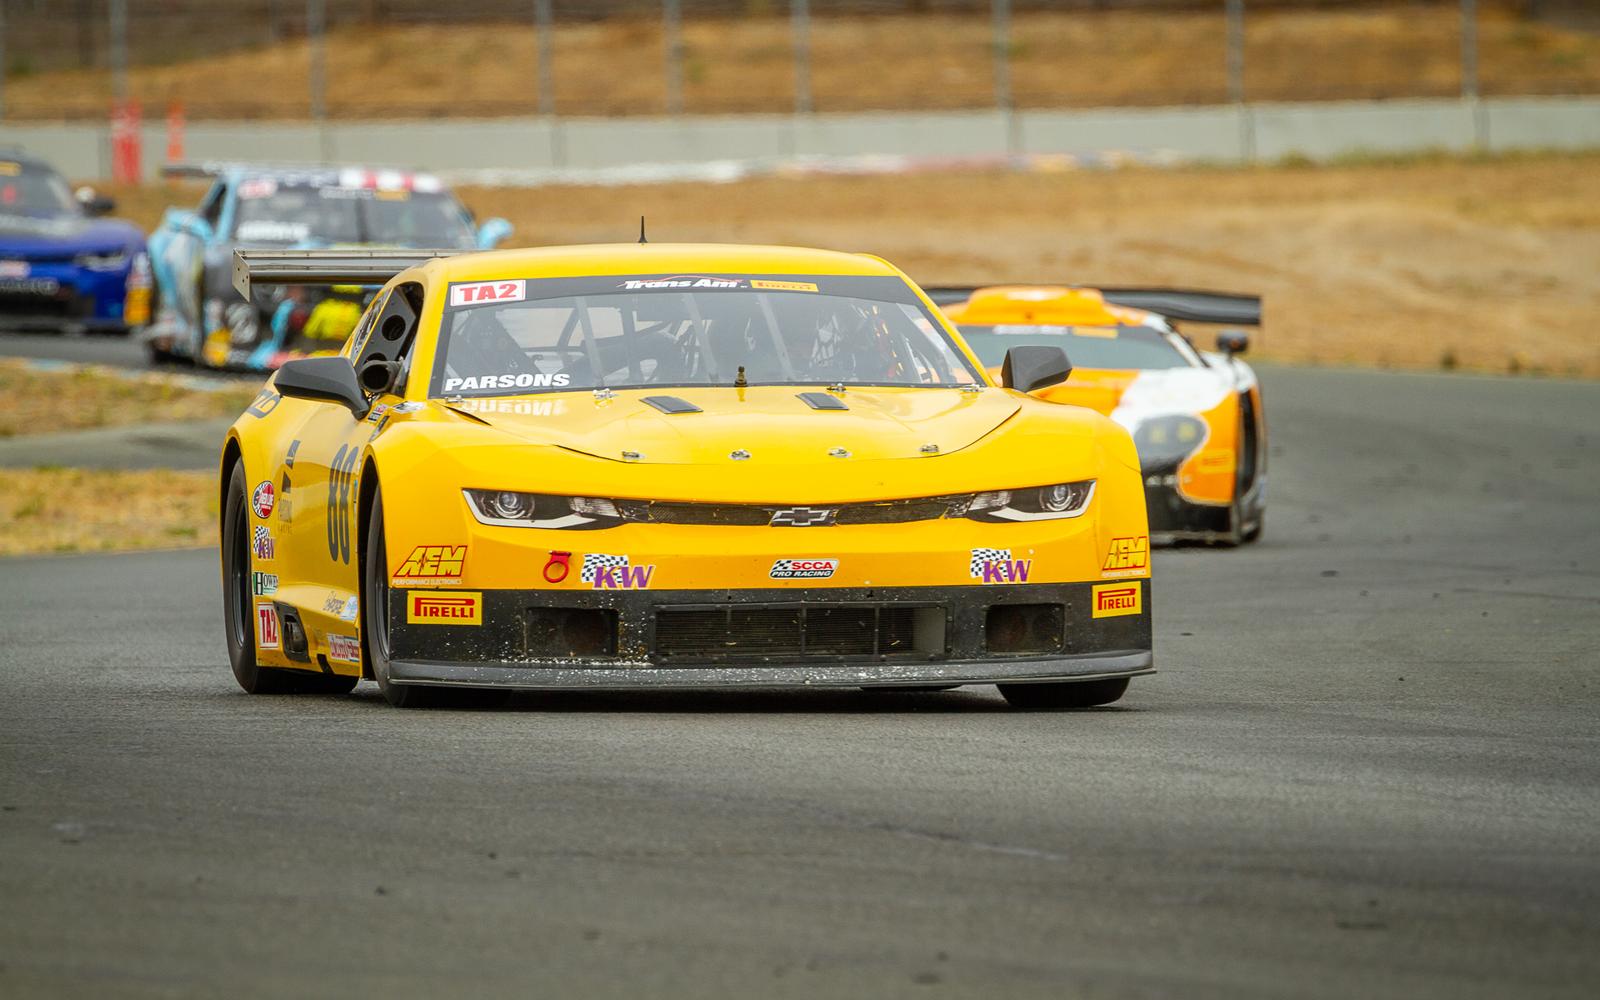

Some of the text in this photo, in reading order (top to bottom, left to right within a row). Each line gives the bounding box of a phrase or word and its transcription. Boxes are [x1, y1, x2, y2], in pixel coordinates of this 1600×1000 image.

[459, 283, 518, 302] TA2
[624, 280, 692, 289] Trans
[692, 279, 739, 288] Am
[445, 374, 570, 391] PARSONS
[327, 443, 359, 565] 88
[393, 546, 467, 577] AEM
[1102, 536, 1147, 571] AEM
[594, 565, 654, 588] KW
[792, 562, 833, 570] SCCA
[983, 560, 1031, 582] KW
[415, 597, 475, 618] PIRELLI
[1098, 588, 1136, 610] PIRELLI
[260, 609, 277, 643] TA2
